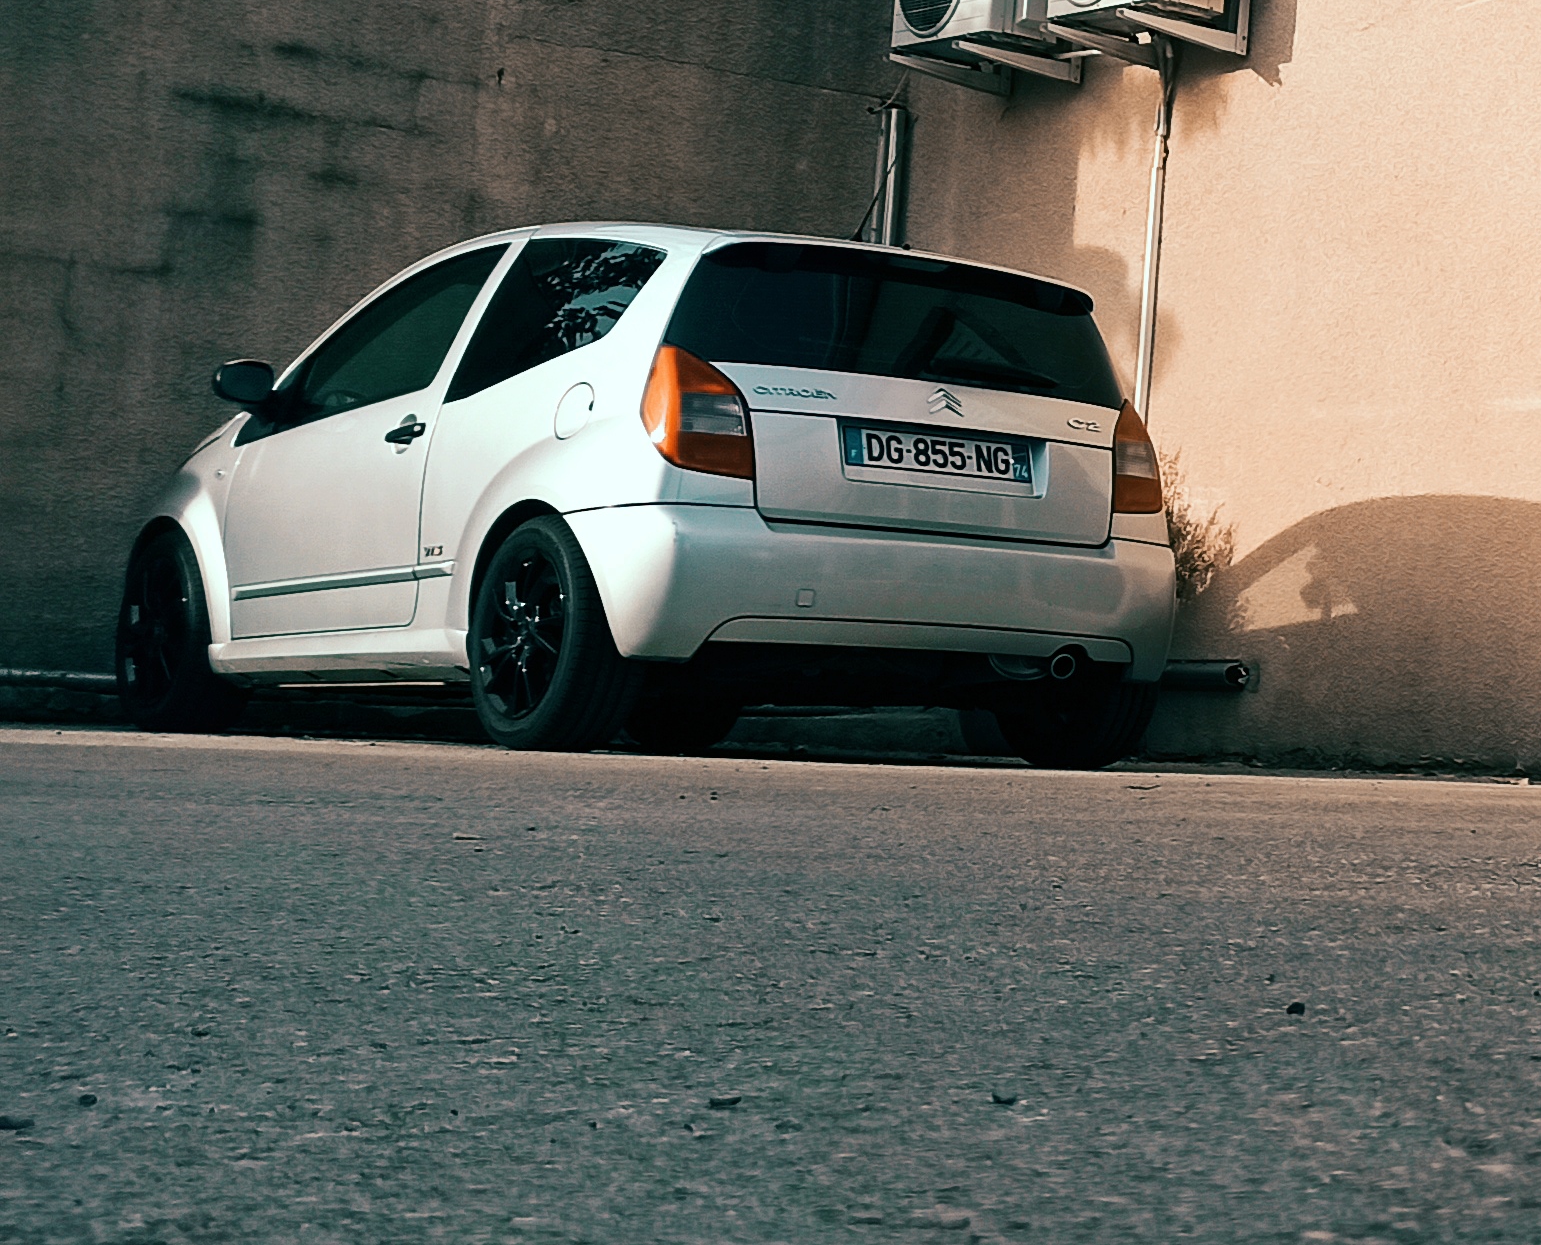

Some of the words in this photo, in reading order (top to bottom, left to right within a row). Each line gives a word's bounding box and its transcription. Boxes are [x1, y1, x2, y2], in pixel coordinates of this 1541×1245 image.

[1066, 416, 1102, 433] C2
[865, 432, 1012, 476] DG-855-NG
[1013, 464, 1029, 479] 74
